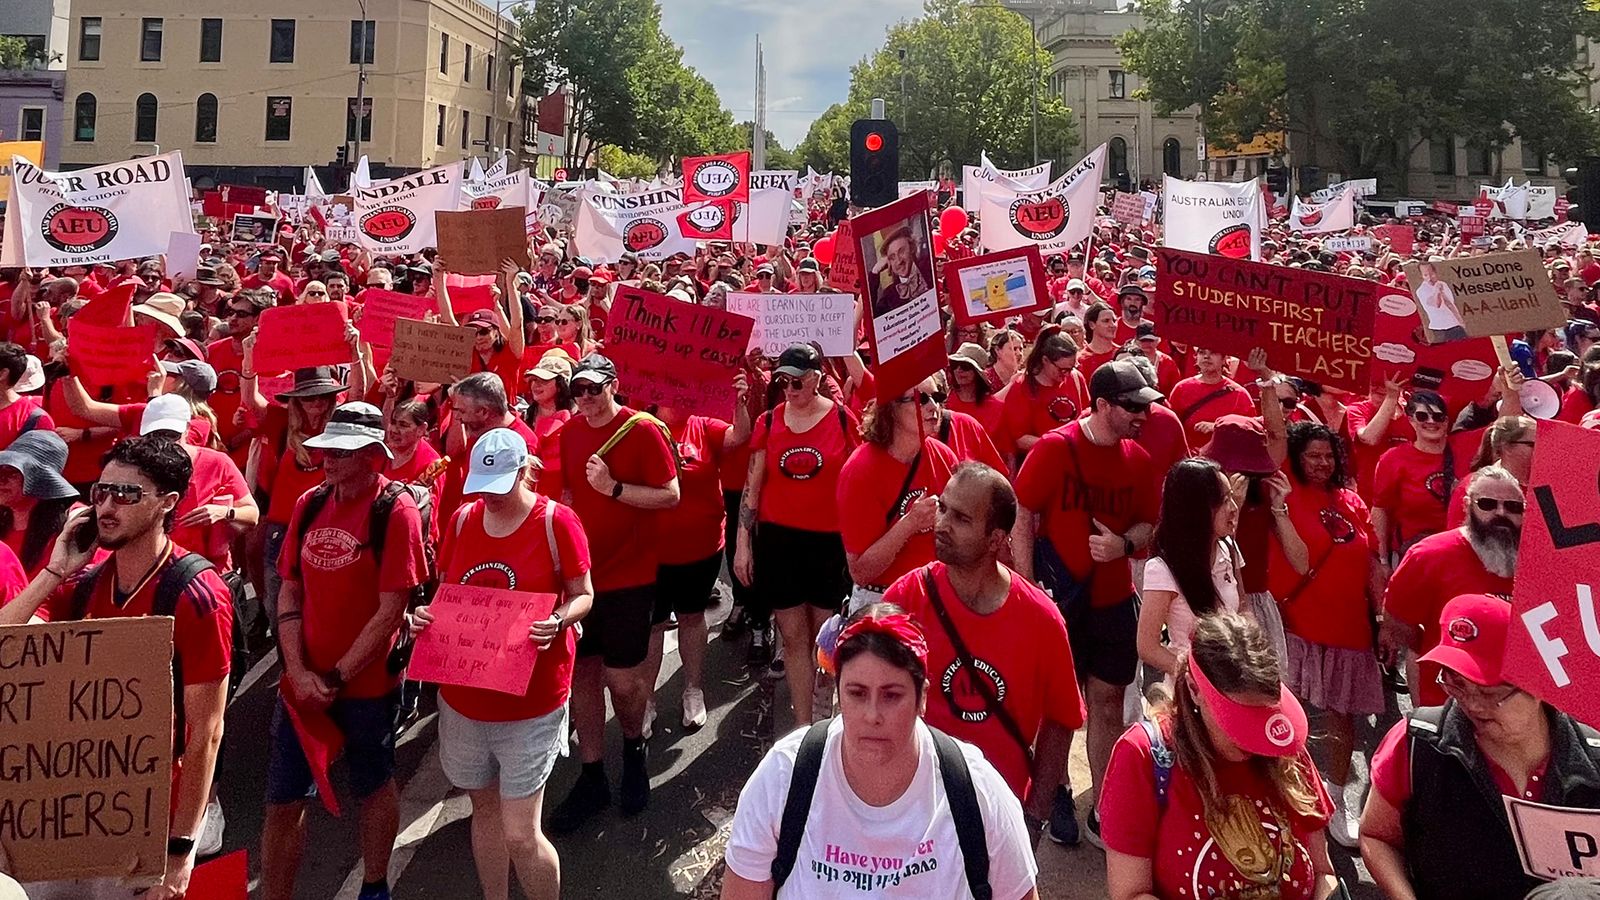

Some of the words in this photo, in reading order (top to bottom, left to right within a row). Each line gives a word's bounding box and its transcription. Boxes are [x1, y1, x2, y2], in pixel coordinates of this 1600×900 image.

[94, 159, 171, 189] ROAD
[488, 174, 520, 189] NORTH
[750, 174, 793, 192] REEK
[81, 189, 130, 203] SCHOOL
[383, 192, 418, 206] SCHOOL
[592, 187, 684, 211] SUNSHIN
[1171, 194, 1236, 207] AUSTRALIAN
[1021, 204, 1061, 223] AEU
[53, 217, 103, 235] AEU
[329, 227, 356, 239] PREMI3
[369, 216, 406, 232] AEU
[379, 235, 400, 243] UNION
[631, 230, 659, 244] AEU
[1031, 231, 1056, 240] UNION
[64, 244, 96, 253] UNION
[50, 257, 69, 265] SUB
[71, 254, 111, 264] BRANCH
[1451, 262, 1482, 280] You
[1485, 259, 1524, 277] Done
[1160, 252, 1209, 280] YOU
[1217, 264, 1292, 296] CAN'T
[1303, 281, 1374, 318] PUT
[1452, 278, 1511, 298] Messed
[1513, 275, 1536, 292] Up
[728, 298, 742, 312] WE
[746, 298, 761, 312] ARE
[766, 298, 815, 312] LEARNING
[820, 297, 833, 310] TO
[623, 294, 680, 333] Think
[717, 319, 743, 341] be
[764, 313, 804, 326] OURSELVES
[807, 314, 817, 323] TO
[820, 312, 846, 323] ACCEPT
[1160, 301, 1208, 326] YOU
[1214, 312, 1259, 338] PUT
[613, 323, 667, 354] giving
[674, 341, 693, 358] up
[765, 328, 780, 339] THE
[782, 327, 809, 338] LOWEST
[815, 327, 824, 337] IN
[828, 326, 842, 335] THE
[1268, 321, 1372, 359] TEACHERS
[1295, 351, 1365, 382] LAST
[482, 454, 495, 467] G
[520, 601, 535, 615] up
[0, 629, 104, 670] CAN'T
[439, 632, 450, 645] us
[507, 643, 523, 655] we
[457, 656, 467, 669] to
[973, 658, 1006, 702] EDUCATION
[67, 677, 144, 723] KIDS
[1271, 723, 1290, 738] AEU
[0, 734, 160, 784] GNORING
[825, 843, 869, 868] Have
[869, 856, 904, 874] you
[911, 839, 935, 858] er
[811, 859, 839, 883] this
[902, 857, 938, 878] ever
[842, 869, 873, 892] like
